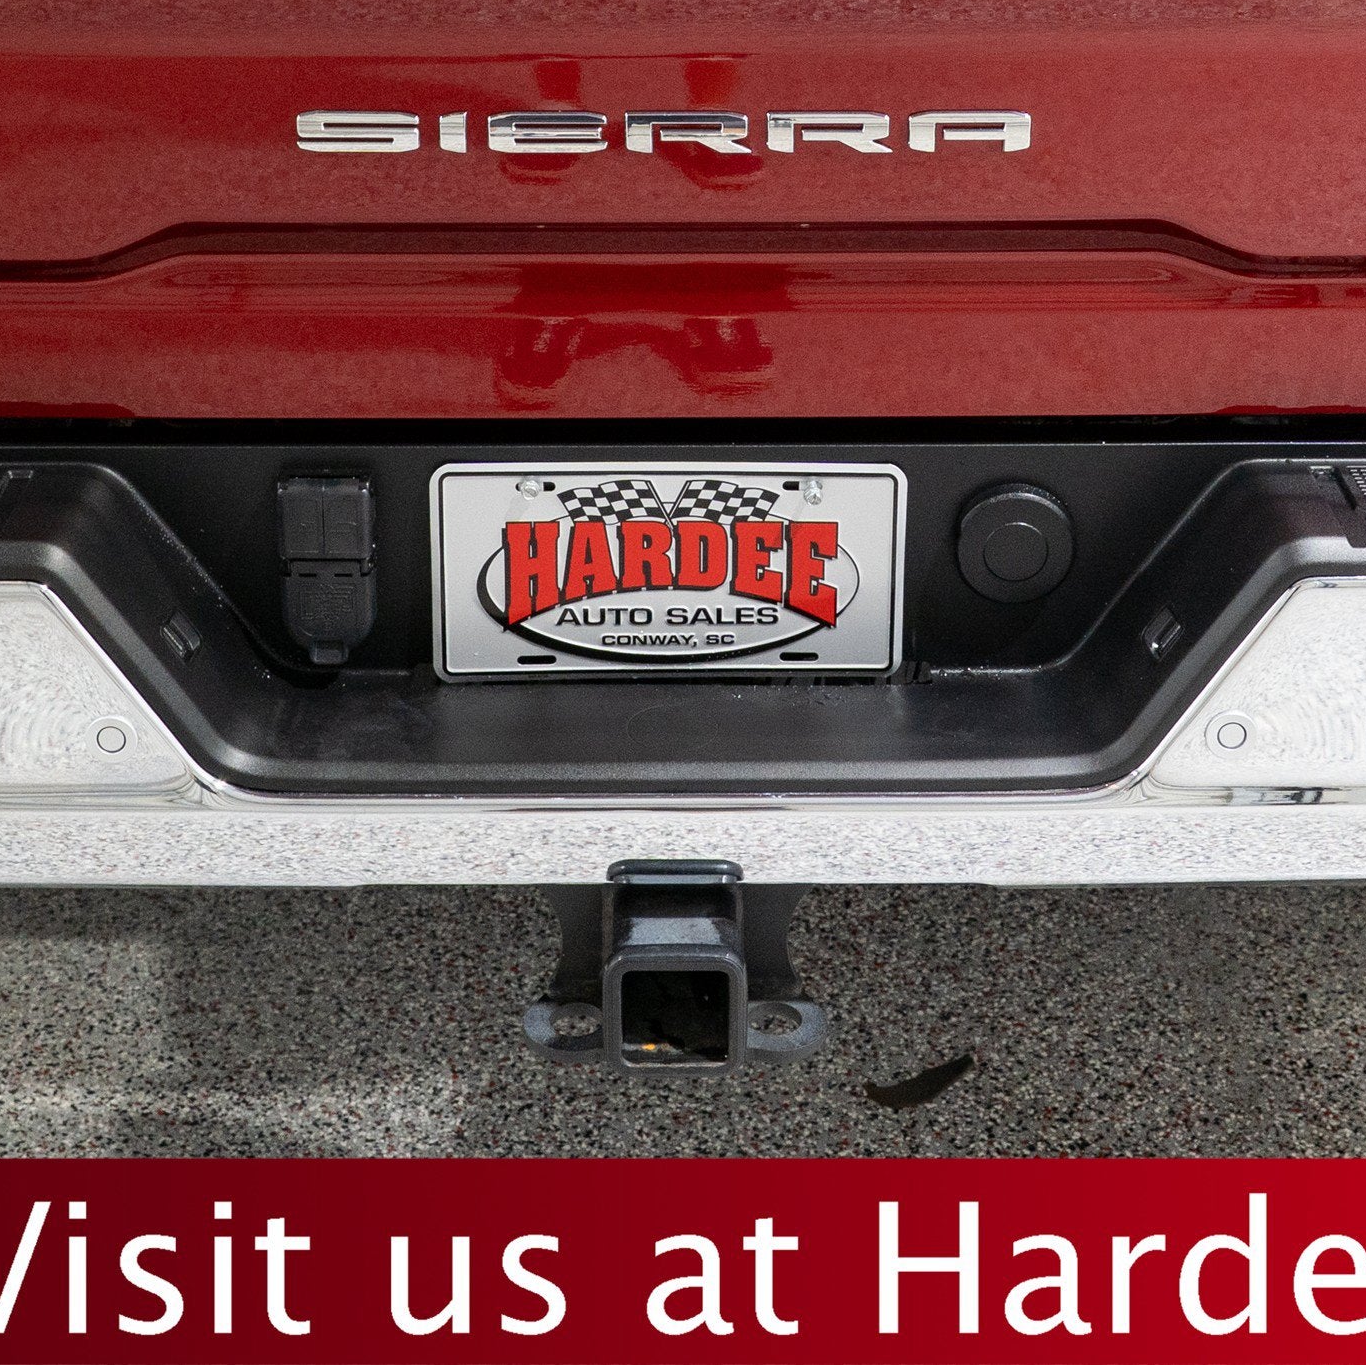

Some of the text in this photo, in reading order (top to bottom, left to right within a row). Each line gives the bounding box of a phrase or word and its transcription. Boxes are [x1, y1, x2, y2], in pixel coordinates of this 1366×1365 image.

[296, 109, 1032, 155] SIERRA
[503, 521, 839, 632] HARDEE
[556, 606, 779, 627] AUTO SALES
[601, 631, 736, 648] CONWAY, SC
